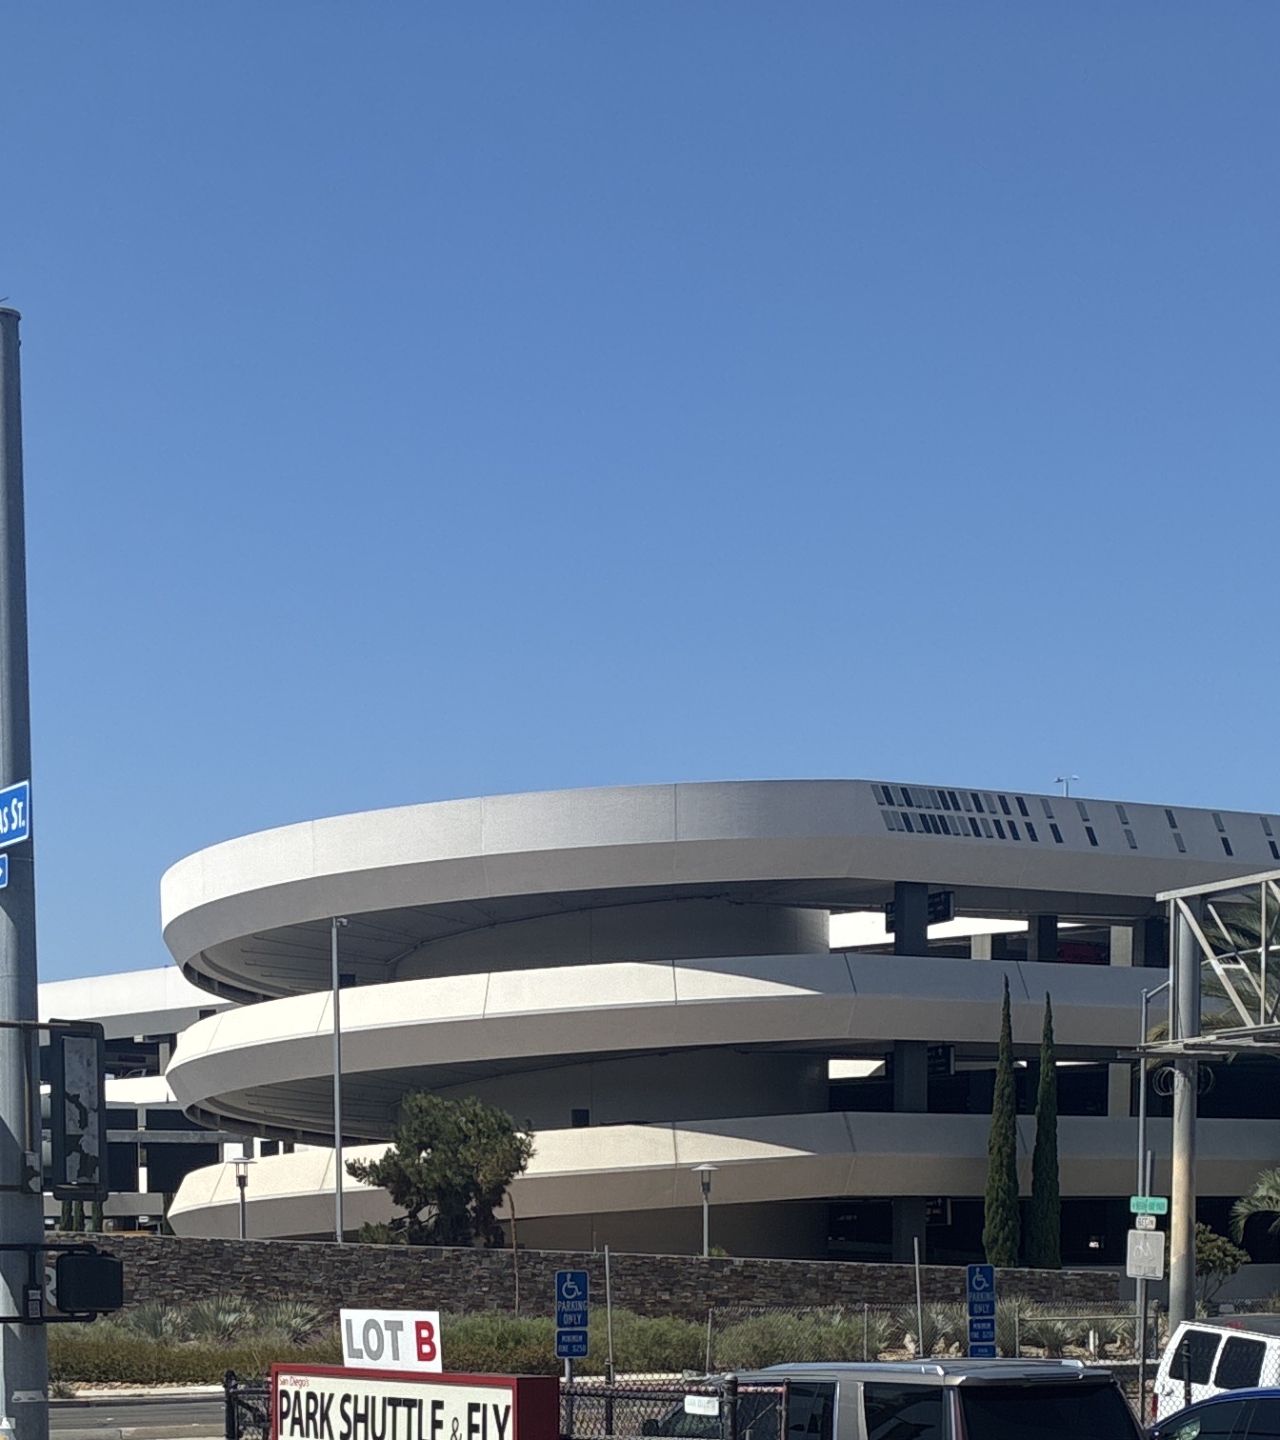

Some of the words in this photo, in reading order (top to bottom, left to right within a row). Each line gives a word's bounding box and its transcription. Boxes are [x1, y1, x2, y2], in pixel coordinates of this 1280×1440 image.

[558, 1301, 588, 1311] PARKING
[563, 1313, 582, 1325] ONLY
[345, 1318, 404, 1361] LOT
[415, 1320, 437, 1362] B
[280, 1389, 335, 1440] PARK
